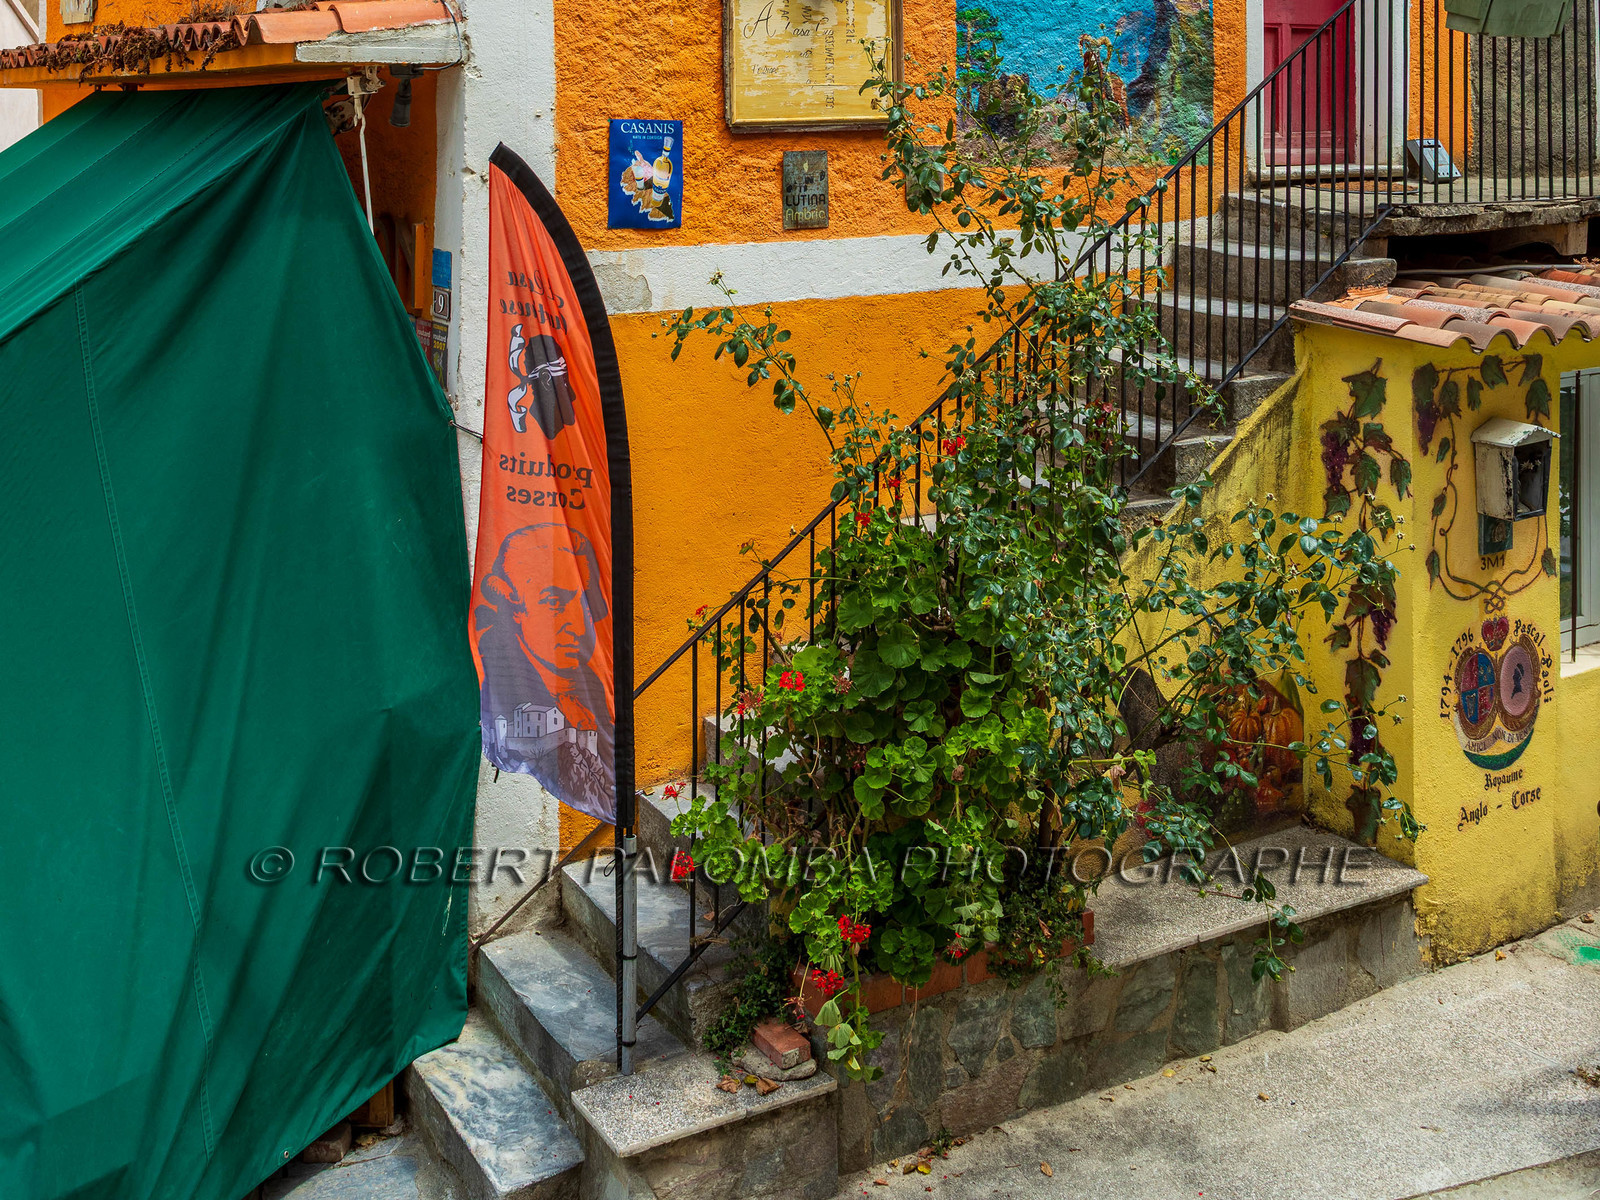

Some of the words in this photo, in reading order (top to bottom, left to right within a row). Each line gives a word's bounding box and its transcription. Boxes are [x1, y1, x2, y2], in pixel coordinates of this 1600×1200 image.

[743, 0, 777, 38] A
[620, 122, 675, 134] CASANIS
[438, 294, 444, 313] 9
[433, 339, 446, 351] 2007
[1484, 769, 1523, 792] Royaume
[1457, 801, 1488, 832] Anglo
[1511, 787, 1541, 810] Corse
